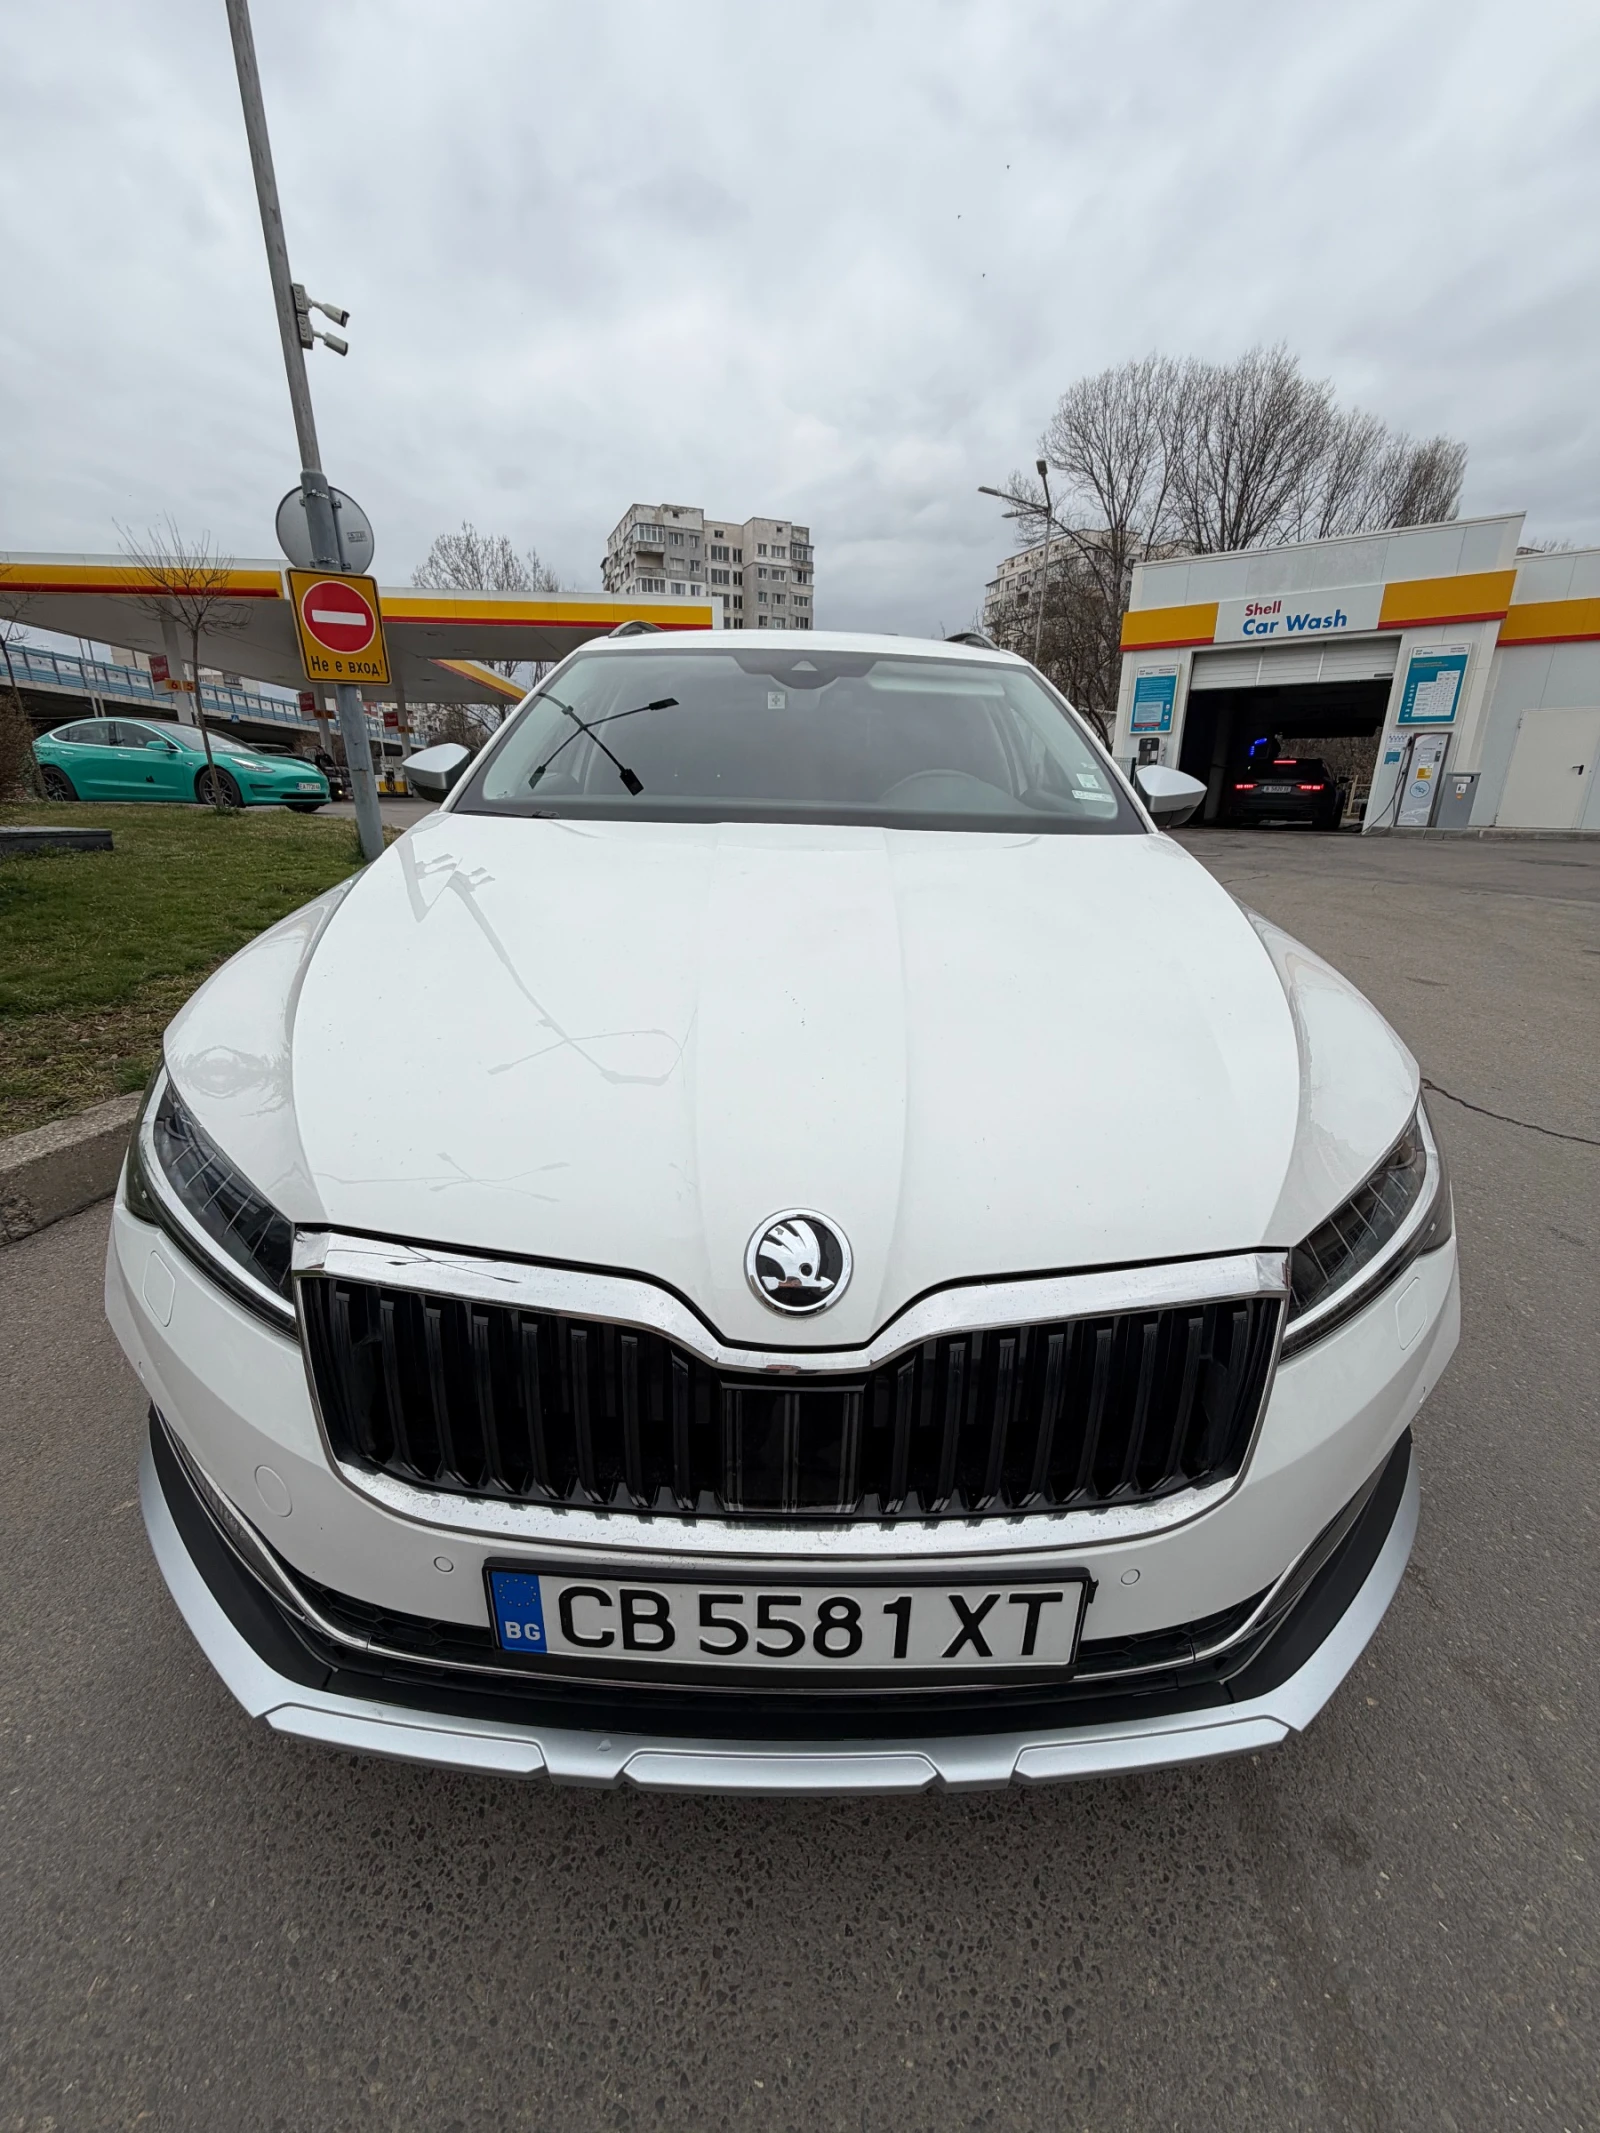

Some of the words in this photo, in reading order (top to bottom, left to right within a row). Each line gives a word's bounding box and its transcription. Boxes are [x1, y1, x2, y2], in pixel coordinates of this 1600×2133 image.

[1244, 600, 1282, 617] Shell
[1242, 618, 1279, 636] Car
[1285, 609, 1348, 631] Wash
[310, 655, 329, 672] Не
[335, 660, 343, 673] е
[347, 659, 383, 677] вход!
[171, 681, 179, 690] 6
[186, 682, 194, 691] 5
[504, 1621, 541, 1641] BG
[558, 1585, 676, 1652] CB
[699, 1592, 912, 1659] 5581
[940, 1591, 1064, 1658] XT
